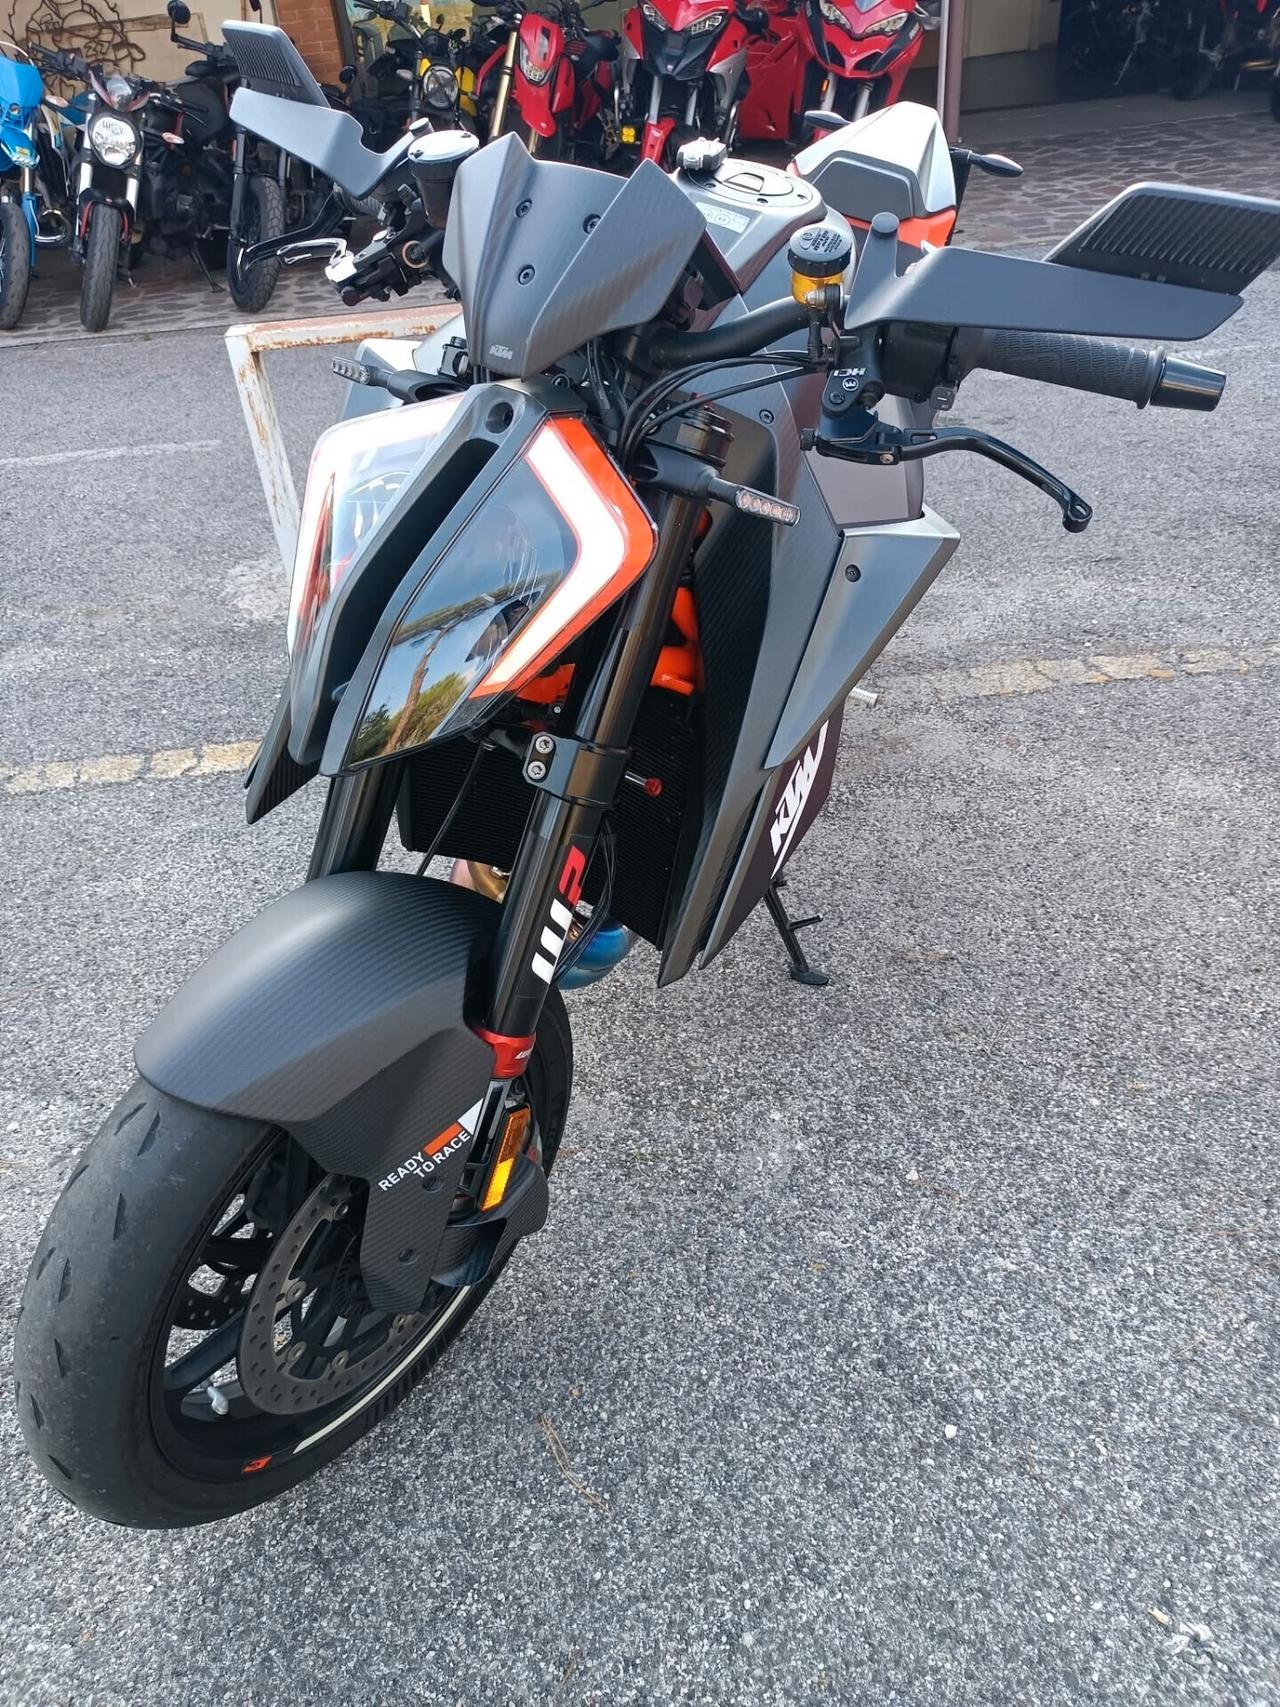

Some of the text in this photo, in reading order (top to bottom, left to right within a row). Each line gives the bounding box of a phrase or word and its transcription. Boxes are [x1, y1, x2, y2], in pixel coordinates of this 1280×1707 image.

[769, 722, 829, 858] KTM
[531, 845, 586, 985] WP
[378, 1151, 425, 1191] READY
[413, 1130, 471, 1178] TO RACE
